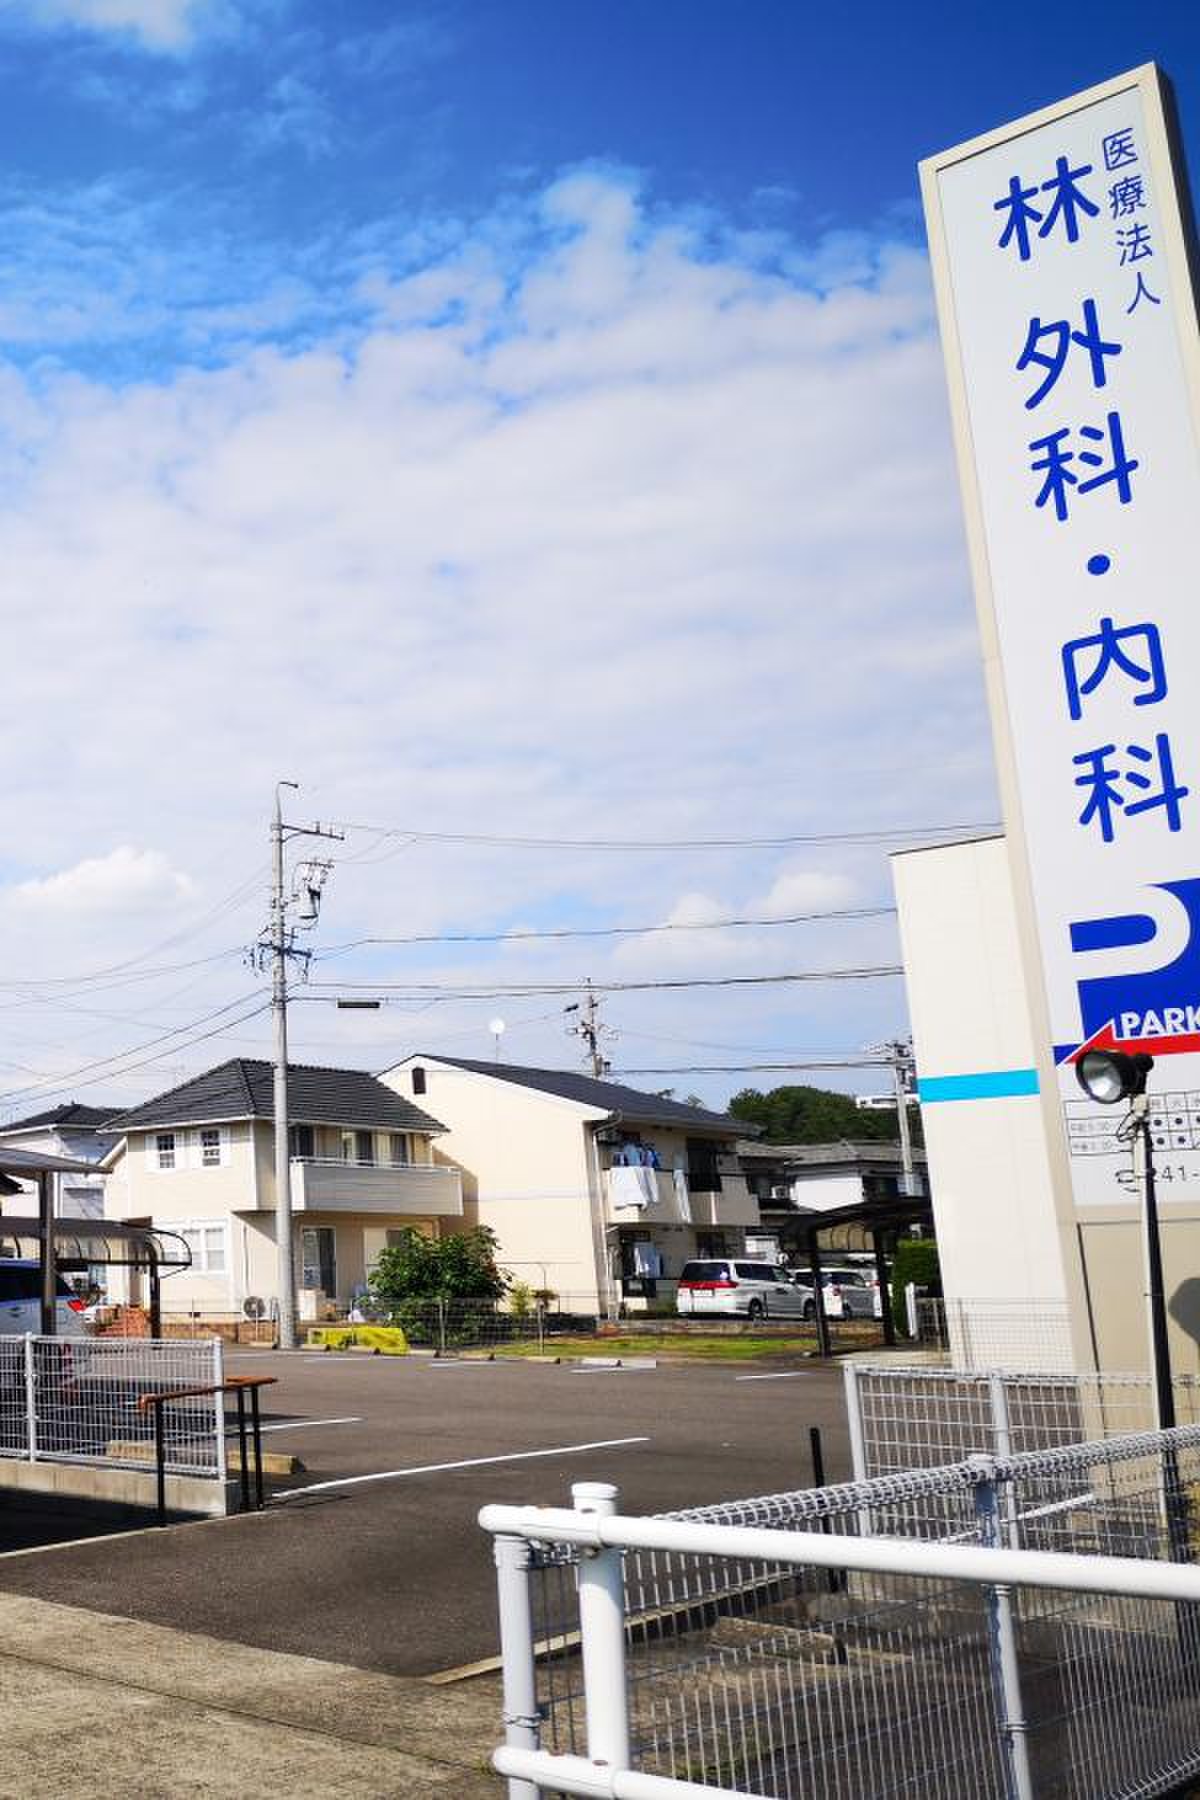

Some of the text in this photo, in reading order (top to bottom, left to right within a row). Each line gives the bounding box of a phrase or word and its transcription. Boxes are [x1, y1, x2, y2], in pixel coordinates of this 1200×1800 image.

[1103, 127, 1162, 314] 医療法人
[1120, 1005, 1200, 1038] PARK
